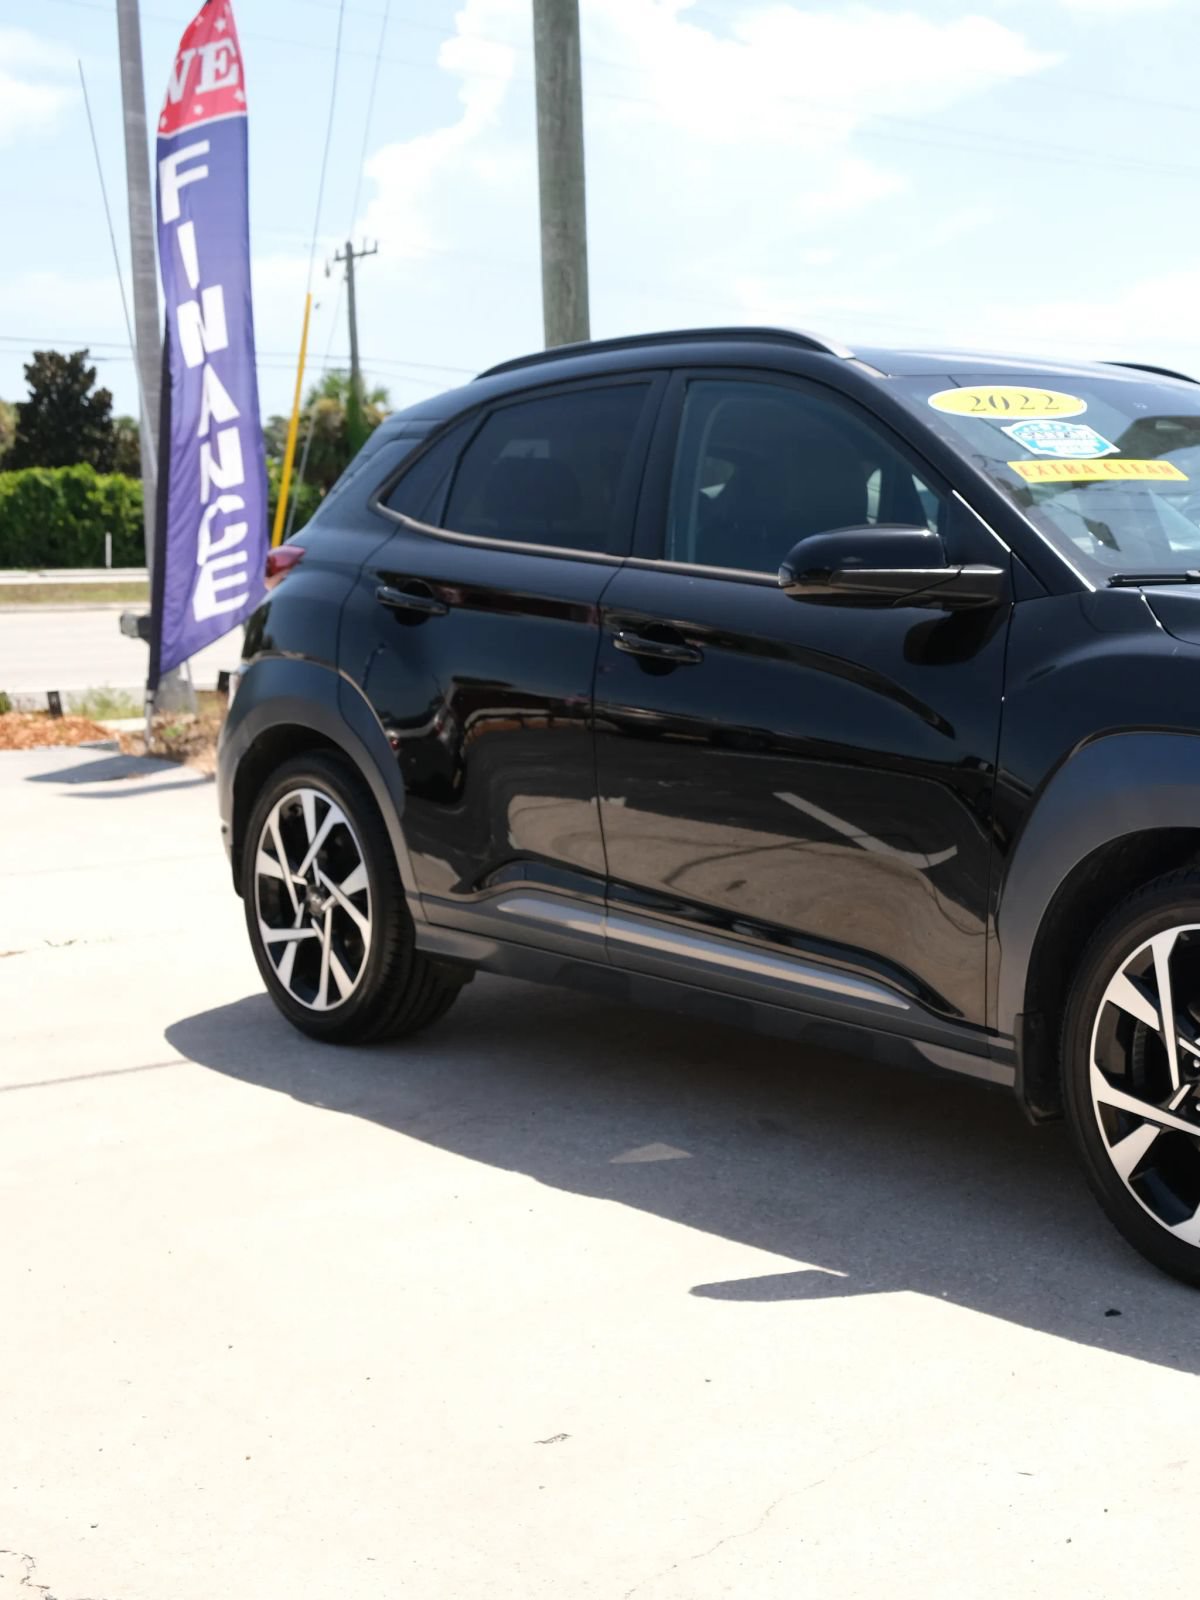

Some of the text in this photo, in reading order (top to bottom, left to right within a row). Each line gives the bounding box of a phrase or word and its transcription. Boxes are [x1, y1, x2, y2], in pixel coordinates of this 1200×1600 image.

[158, 139, 249, 622] FINANCE
[970, 394, 1060, 412] 2022
[1018, 463, 1175, 477] EXTRA CLEAN
